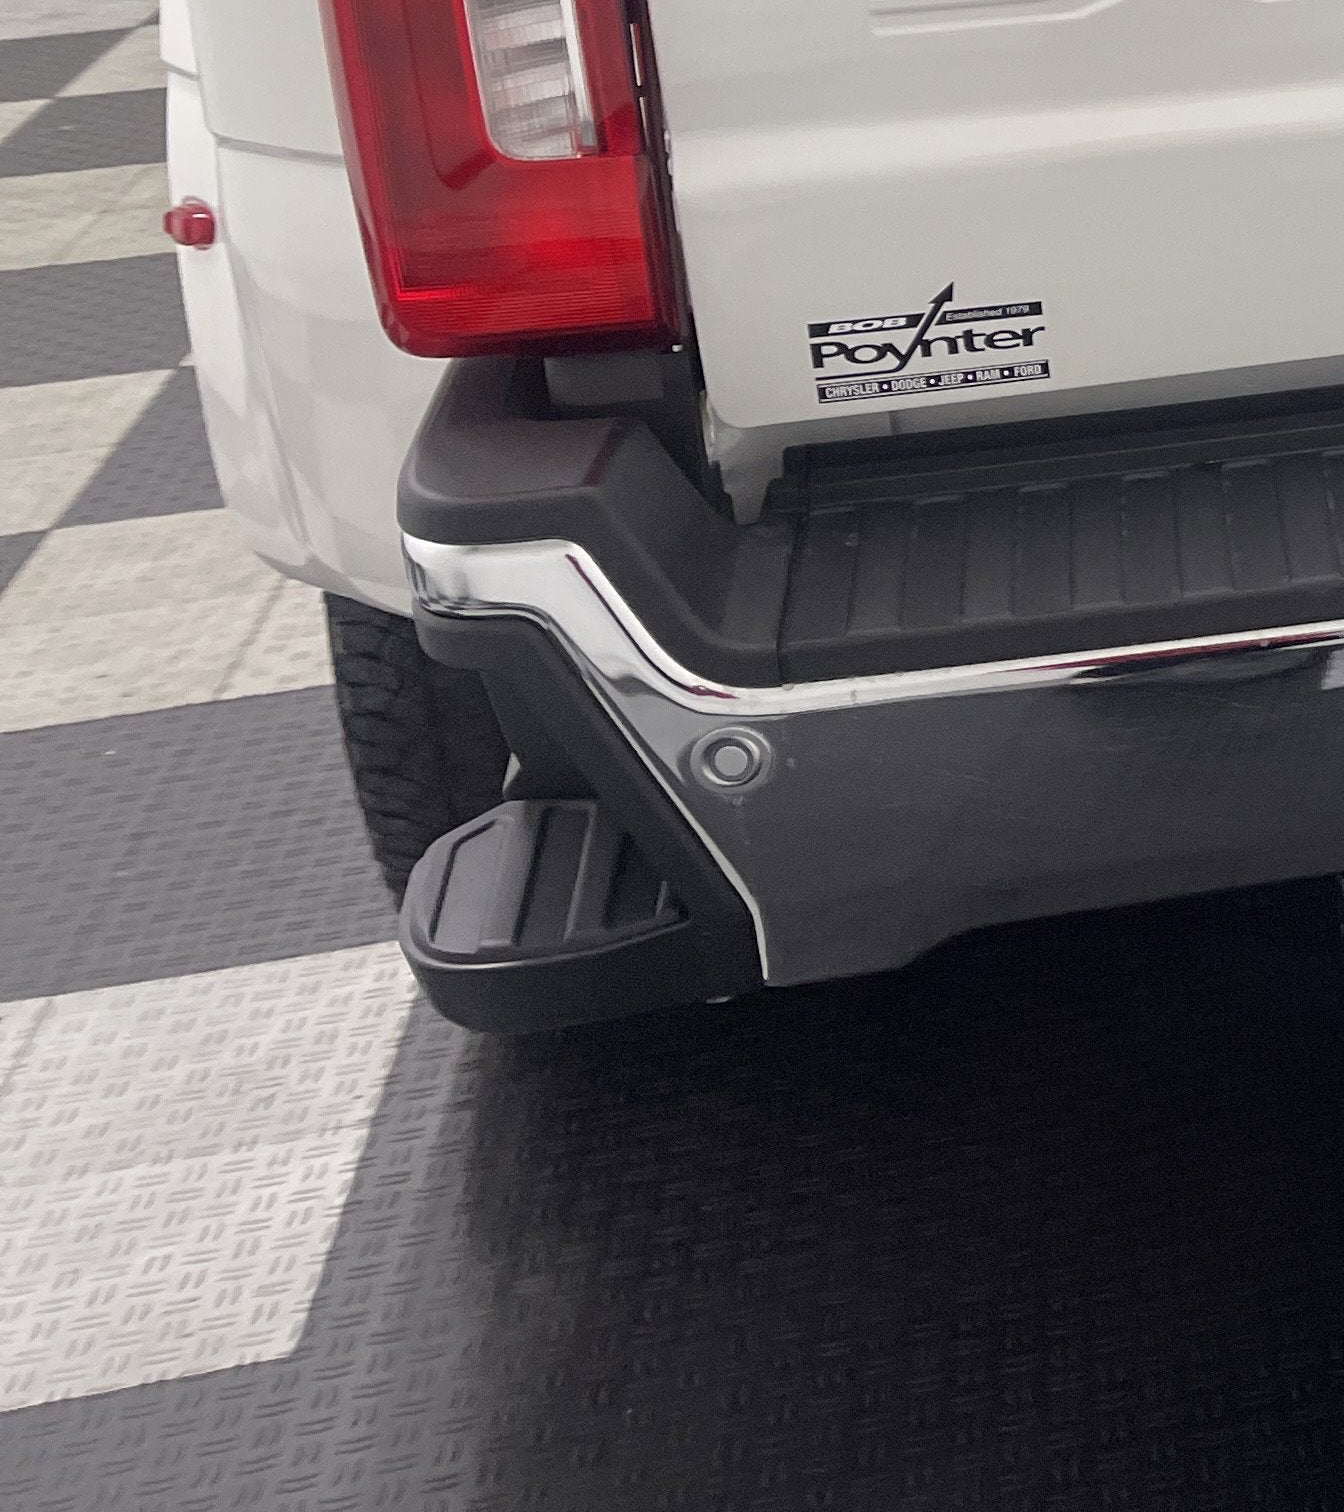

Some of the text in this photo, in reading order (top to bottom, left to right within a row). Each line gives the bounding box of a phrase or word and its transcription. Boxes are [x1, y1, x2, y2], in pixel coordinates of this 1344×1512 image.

[827, 316, 908, 335] BOB
[945, 304, 1030, 322] Established 1979
[808, 325, 1046, 373] Poynter
[825, 363, 1042, 400] CHRYSLER DODGE JEEP RAM FORD
